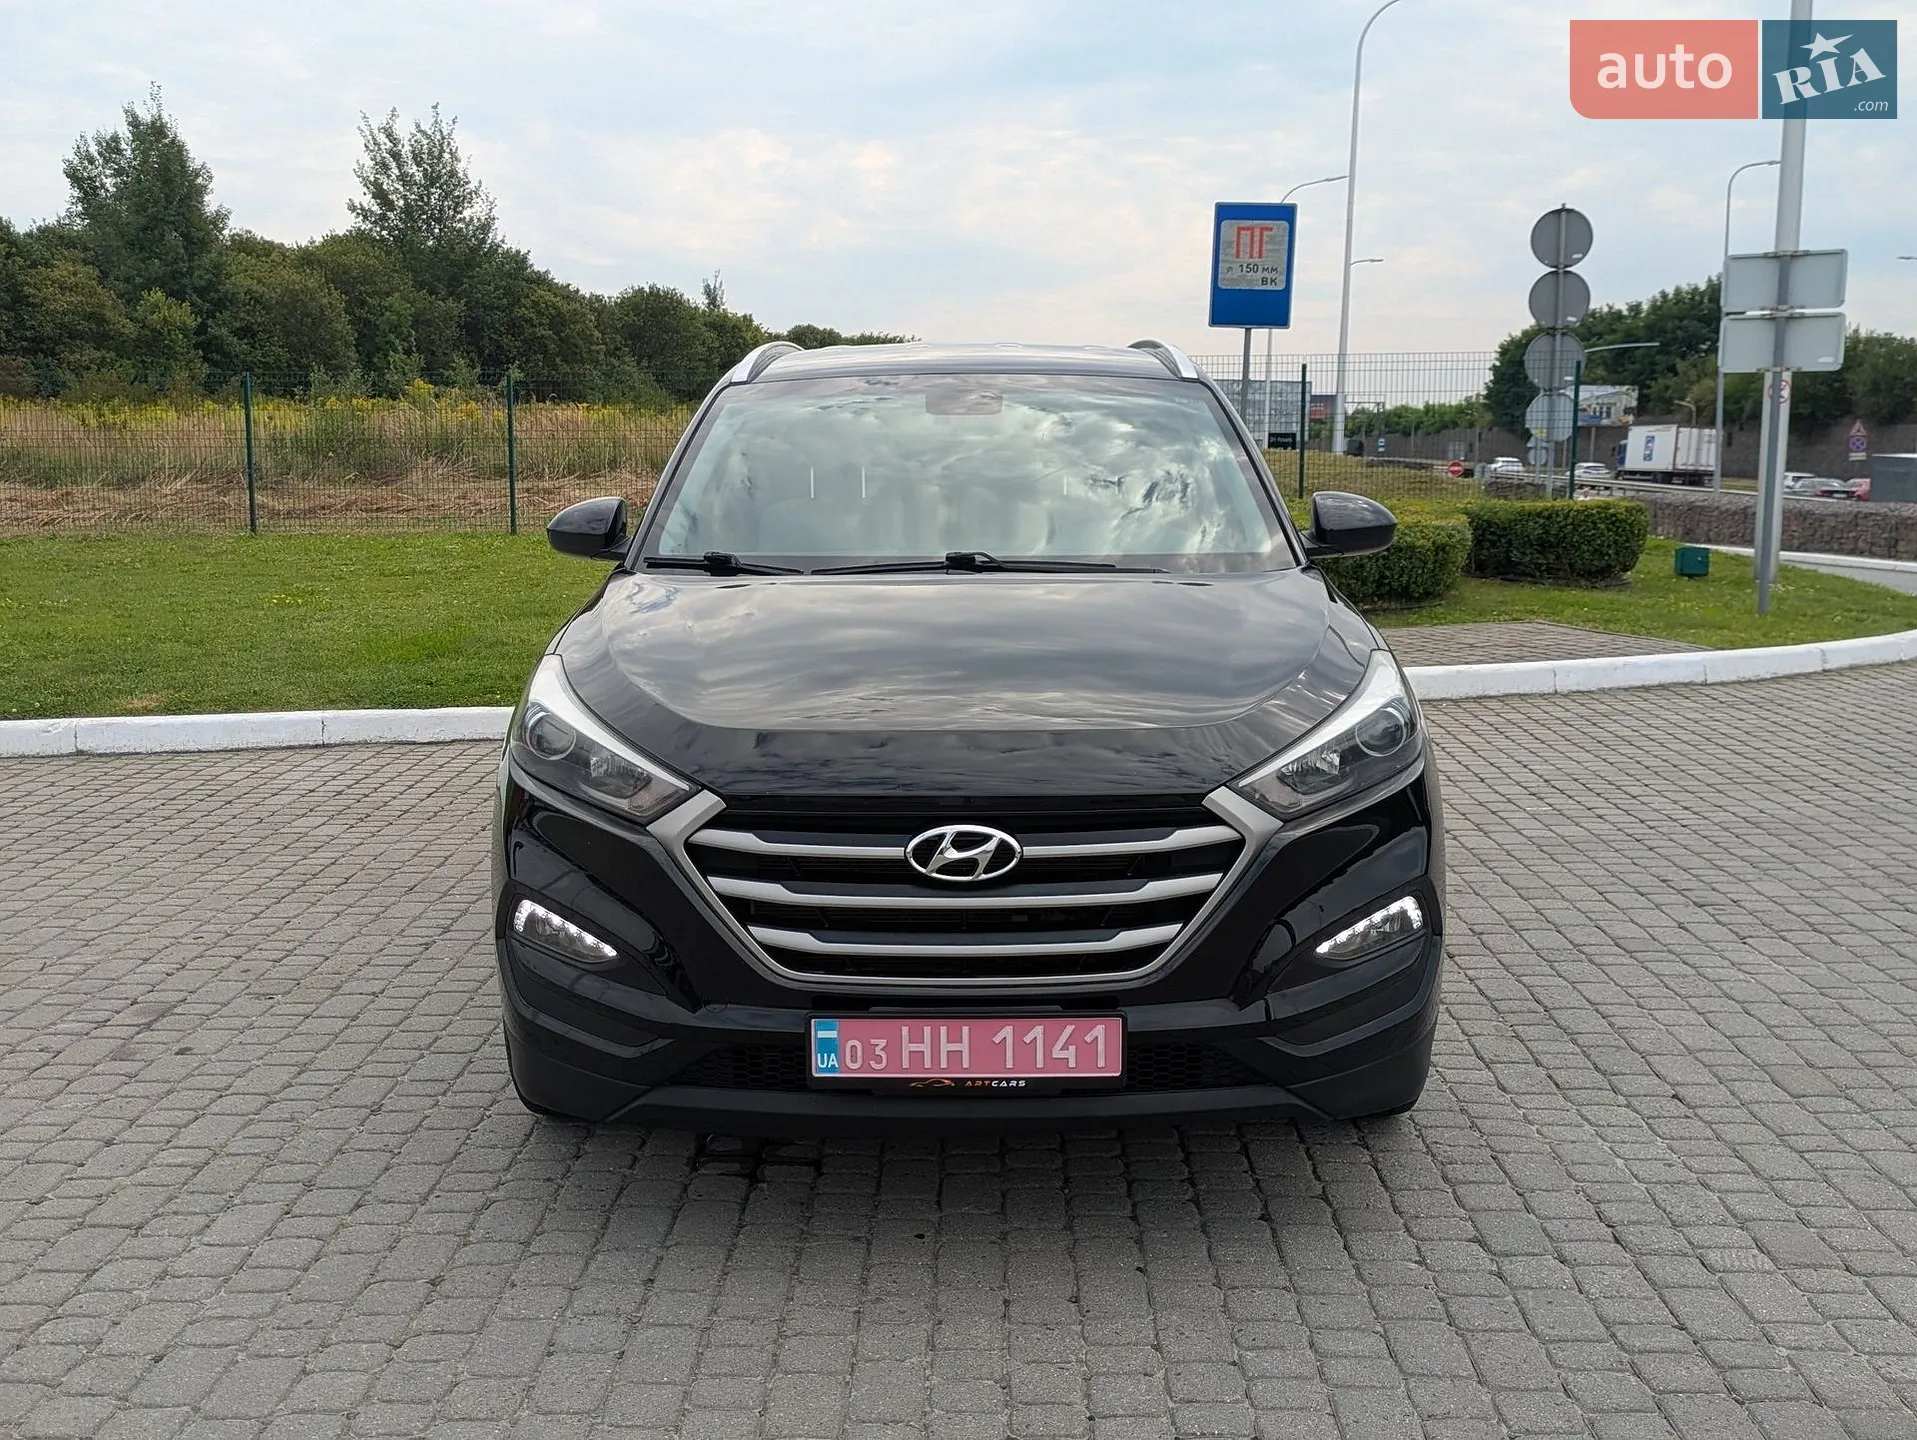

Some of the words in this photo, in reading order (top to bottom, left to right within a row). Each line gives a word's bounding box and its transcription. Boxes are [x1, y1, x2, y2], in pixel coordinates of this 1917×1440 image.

[1234, 226, 1274, 259] ПГ
[1239, 263, 1259, 273] 150
[817, 1052, 839, 1069] UA
[845, 1039, 888, 1070] 03
[992, 1024, 1107, 1069] 1141
